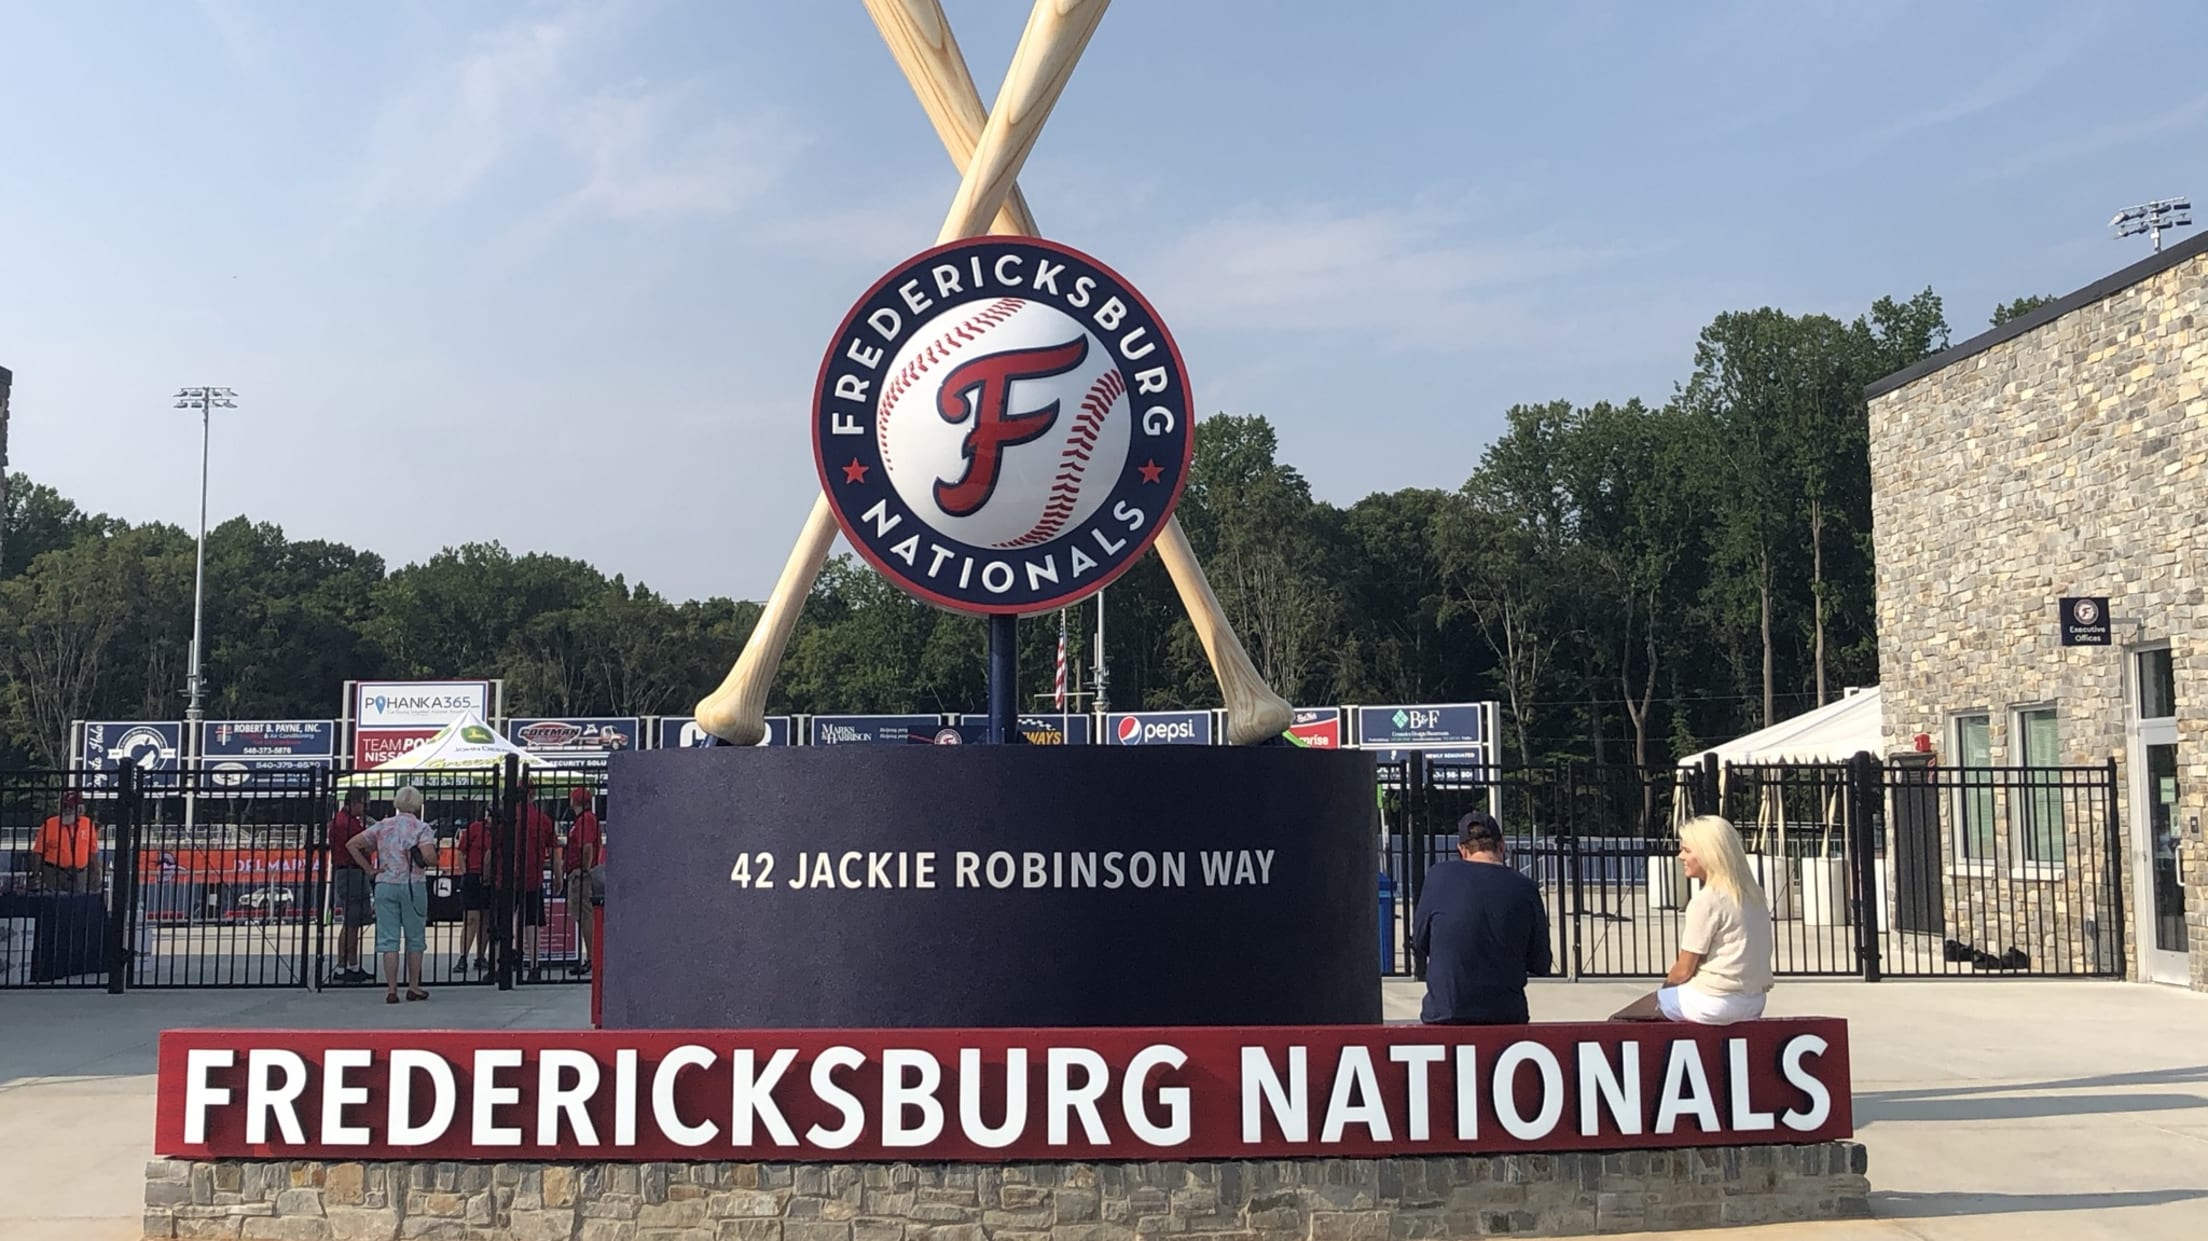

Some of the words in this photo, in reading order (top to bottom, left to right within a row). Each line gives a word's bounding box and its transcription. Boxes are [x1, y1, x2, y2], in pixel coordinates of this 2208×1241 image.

[831, 254, 1176, 436] FREDERICKSBURG
[933, 333, 1089, 518] F
[860, 498, 1146, 594] NATIONALS
[2069, 625, 2106, 634] Executive
[2074, 634, 2102, 642] Offices
[1409, 710, 1440, 729] B&F
[234, 723, 263, 733] ROBERT
[275, 723, 303, 734] PAYNE,
[304, 723, 322, 733] INC.
[821, 723, 856, 734] MARKS
[1144, 718, 1194, 743] pepsi
[362, 738, 402, 751] TEAM
[1023, 731, 1063, 745] WAYS
[586, 759, 608, 767] SOLU
[731, 852, 774, 889] 42
[789, 851, 935, 889] JACKIE
[957, 850, 1185, 888] ROBINSON
[1201, 849, 1275, 886] WAY
[184, 1045, 1190, 1149] FREDERICKSBURG
[1242, 1030, 1831, 1144] NATIONALS
